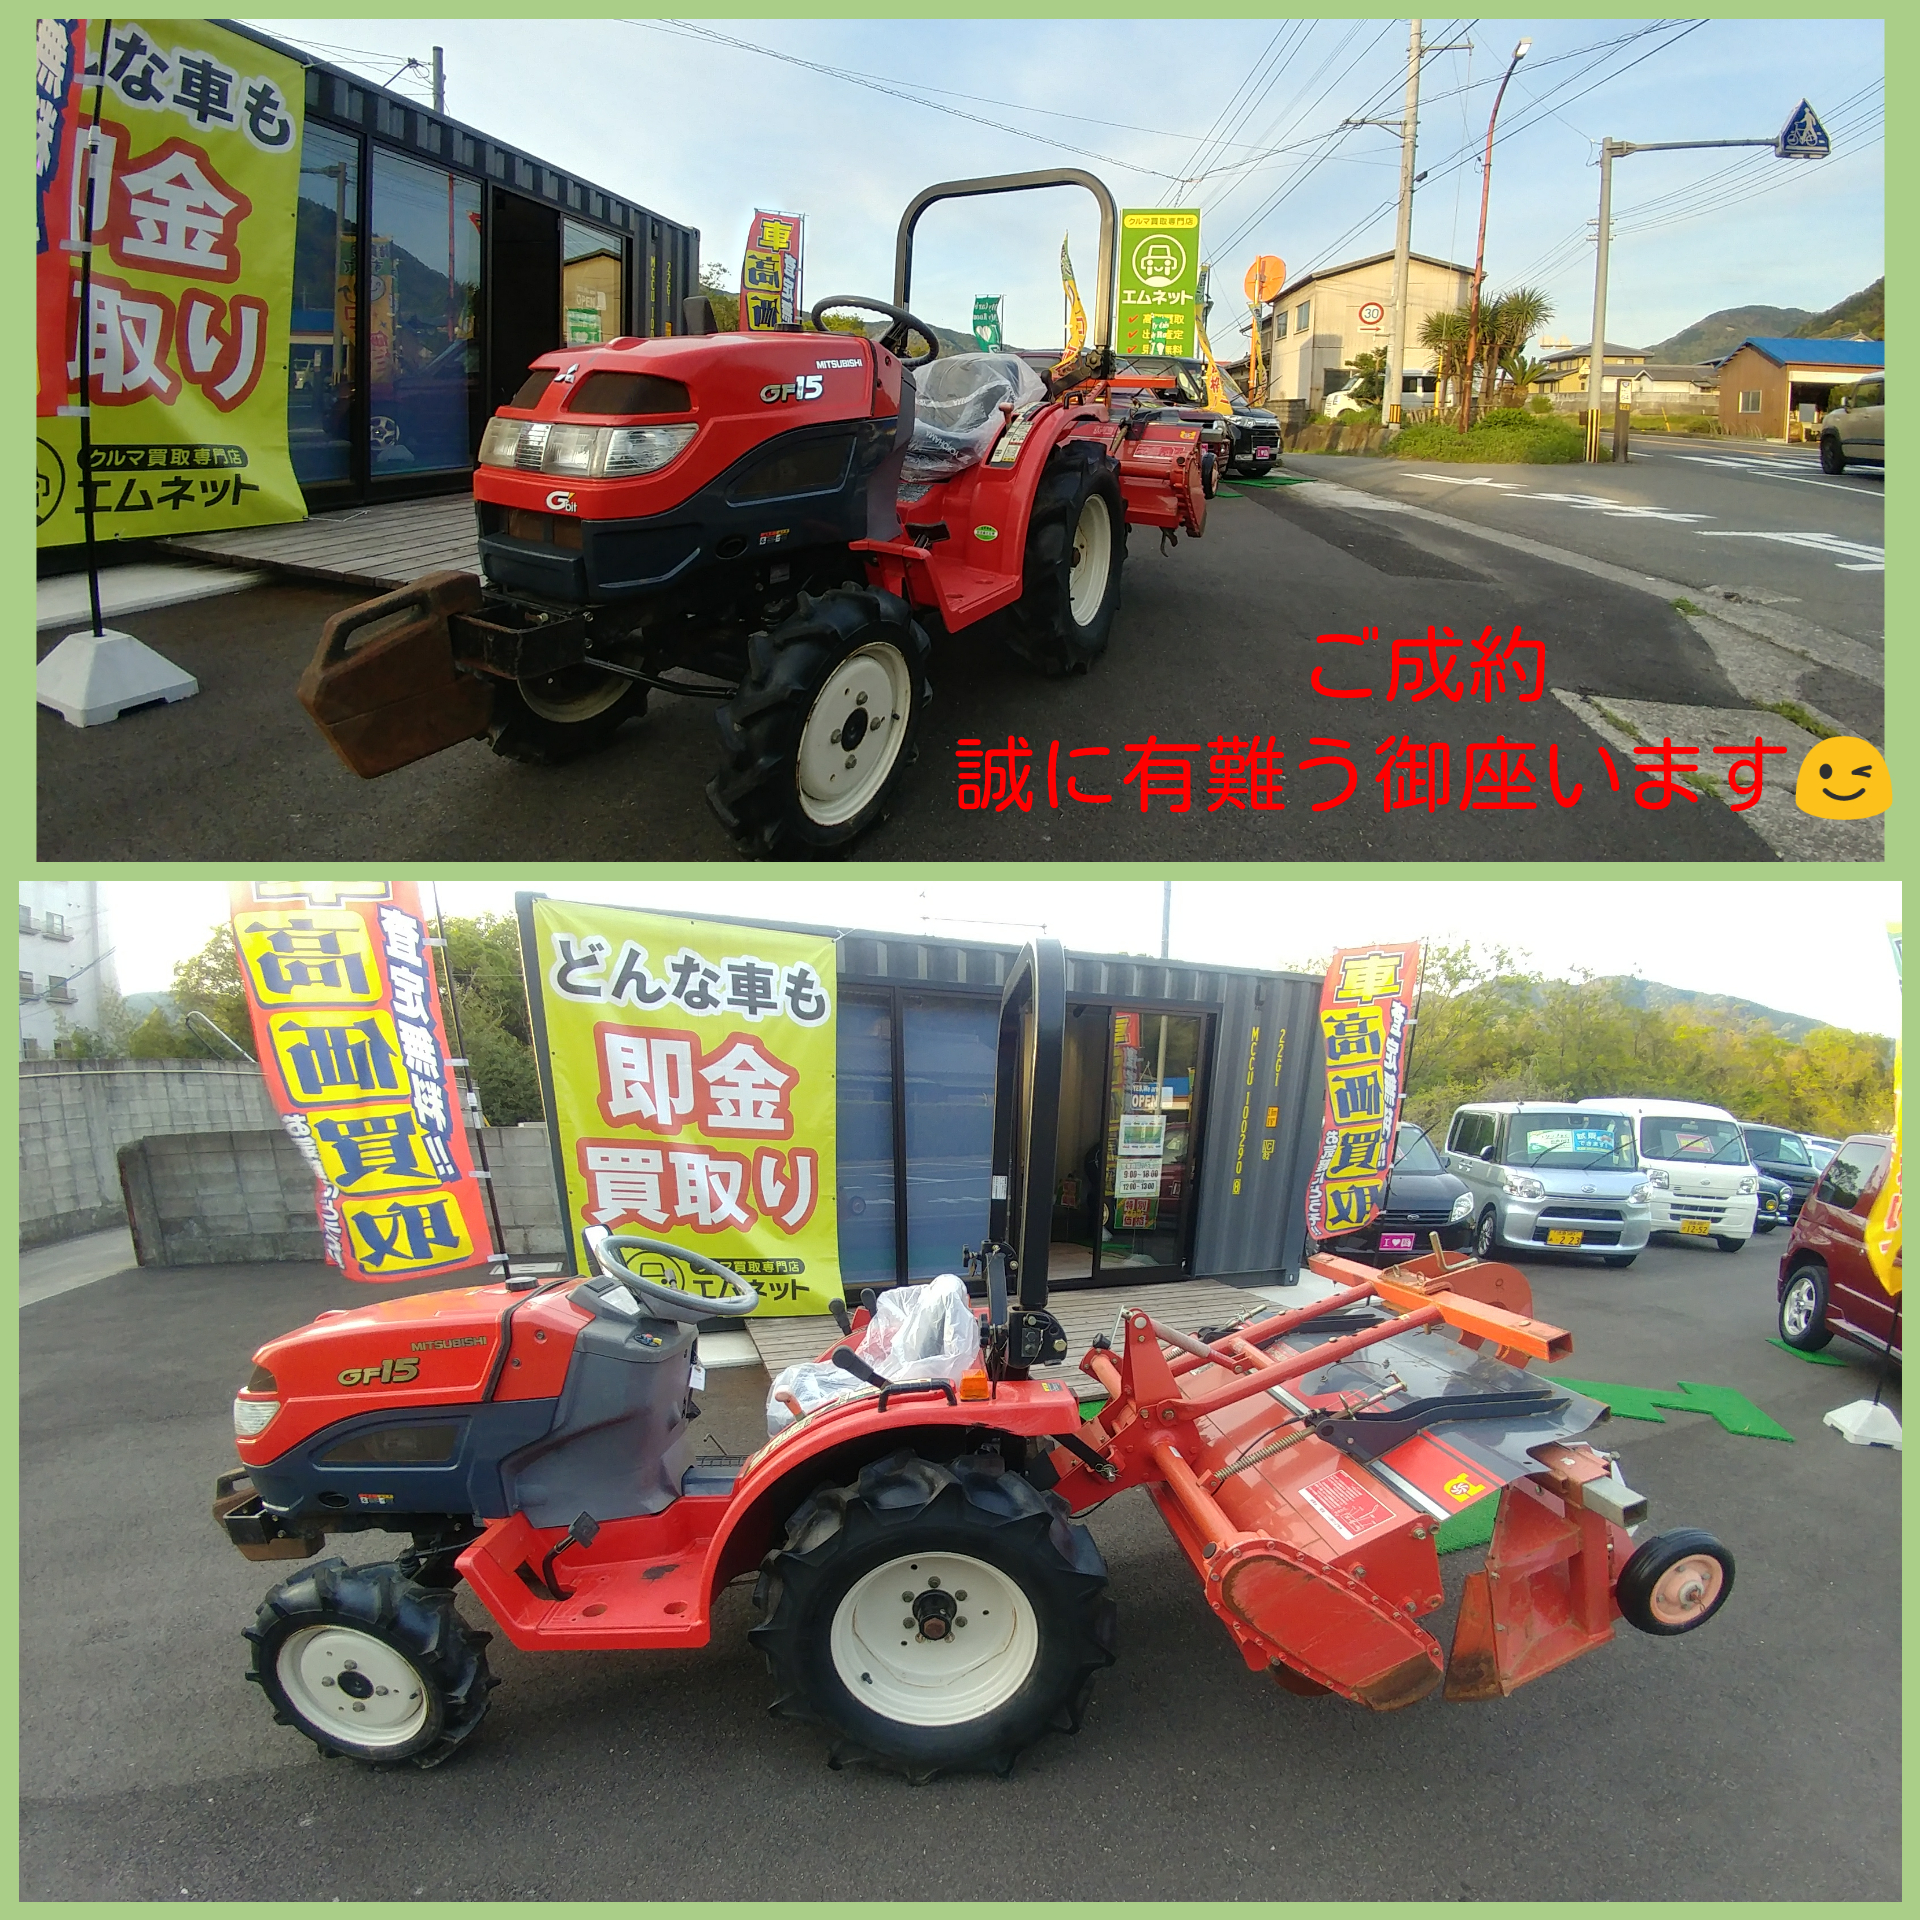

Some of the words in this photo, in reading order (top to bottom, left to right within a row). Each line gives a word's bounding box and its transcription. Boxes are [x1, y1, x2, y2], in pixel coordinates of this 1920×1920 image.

[84, 32, 292, 147] な車も
[1128, 217, 1194, 226] クルマ買取専門店
[1121, 290, 1194, 306] エムネット
[1364, 309, 1379, 318] 30
[816, 359, 862, 369] MITSUBISHI
[760, 375, 822, 402] GF15
[90, 449, 243, 467] クルマ買取専門店
[75, 474, 260, 514] エムネット
[554, 935, 828, 1022] どんな車も
[1246, 1026, 1260, 1085] MCCU
[1274, 1029, 1286, 1086] 22G1
[600, 1032, 791, 1132] 即金
[1132, 1095, 1158, 1107] OPEN
[1235, 1091, 1251, 1174] 100290
[585, 1147, 818, 1228] 買取り
[411, 1336, 487, 1351] MITSUBISHI
[337, 1357, 419, 1386] GF15
